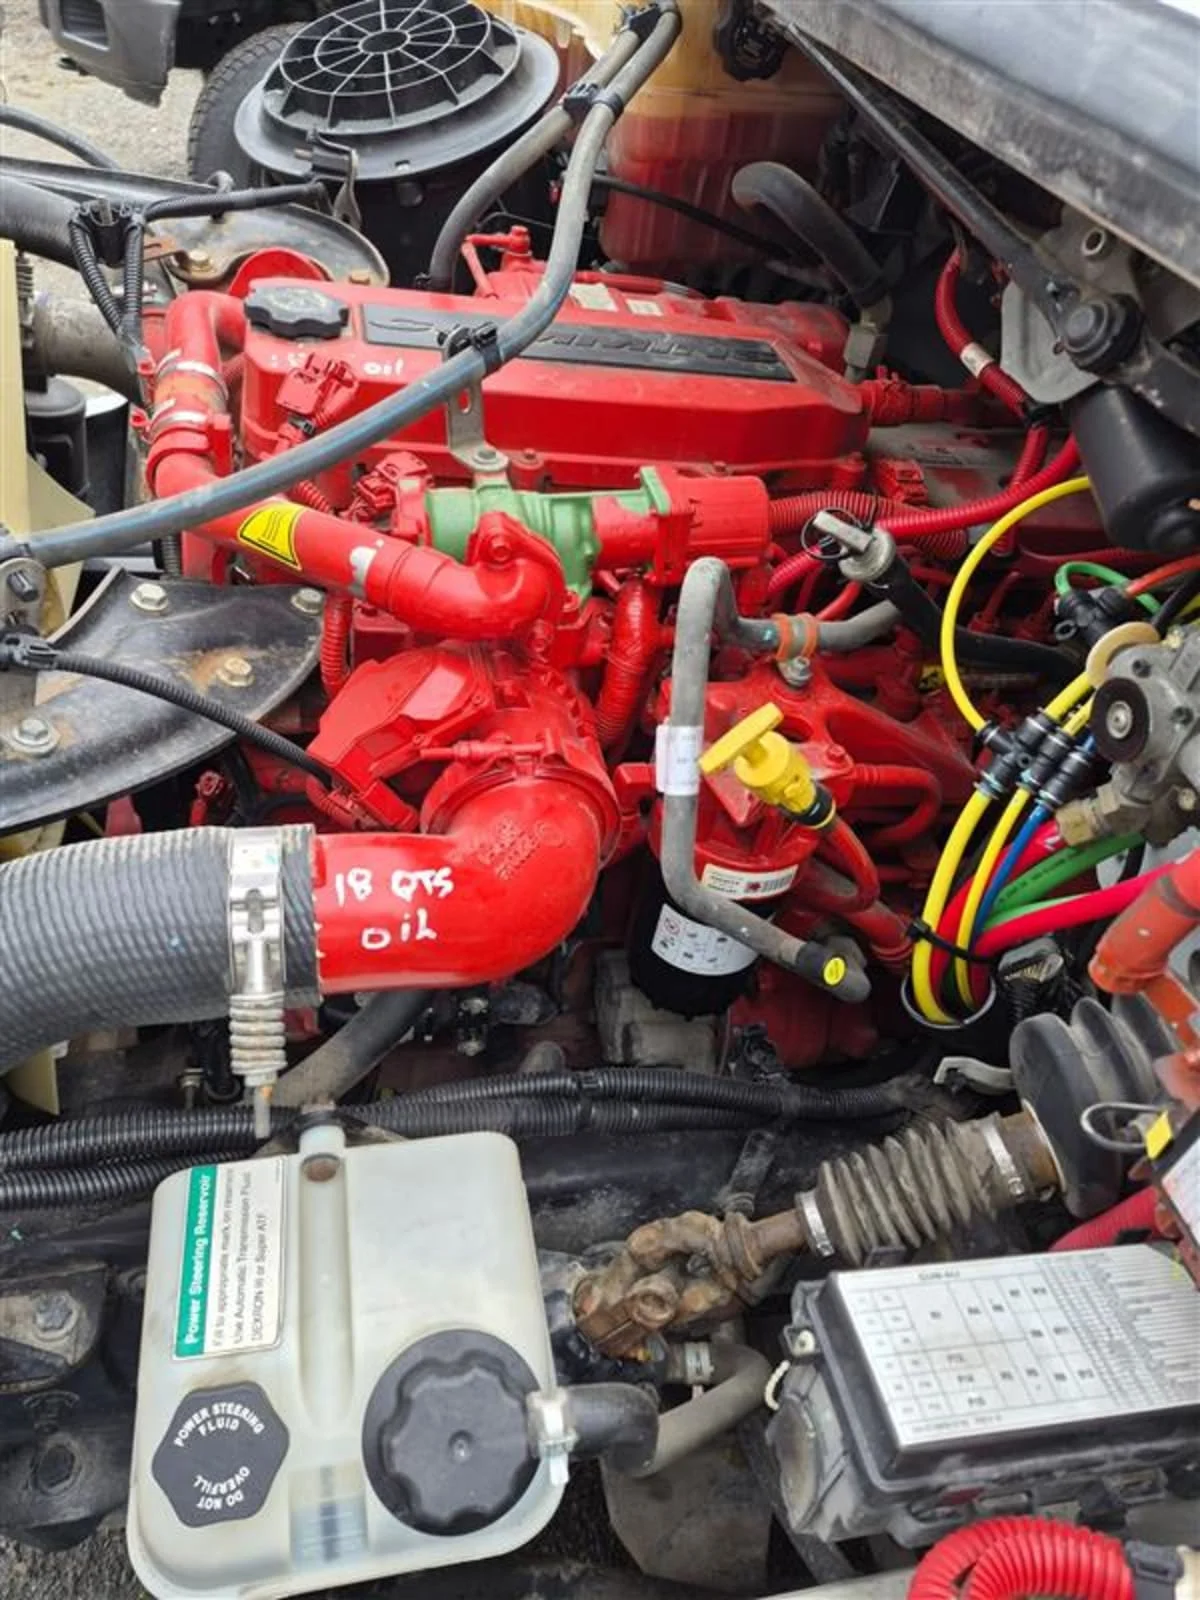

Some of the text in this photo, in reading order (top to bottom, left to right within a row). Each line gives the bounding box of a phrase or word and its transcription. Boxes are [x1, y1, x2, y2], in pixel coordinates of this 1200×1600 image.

[335, 867, 373, 907] 18
[221, 1225, 232, 1251] mark
[235, 1198, 250, 1262] Transmission
[254, 1233, 267, 1262] Super
[184, 1173, 211, 1344] Power Steering Reservoir
[233, 1264, 248, 1319] Automatic
[173, 1401, 266, 1448] POWER STEERING
[198, 1416, 241, 1437] FLUID
[193, 1465, 251, 1496] OVERFILL
[195, 1488, 244, 1510] DO NOT
